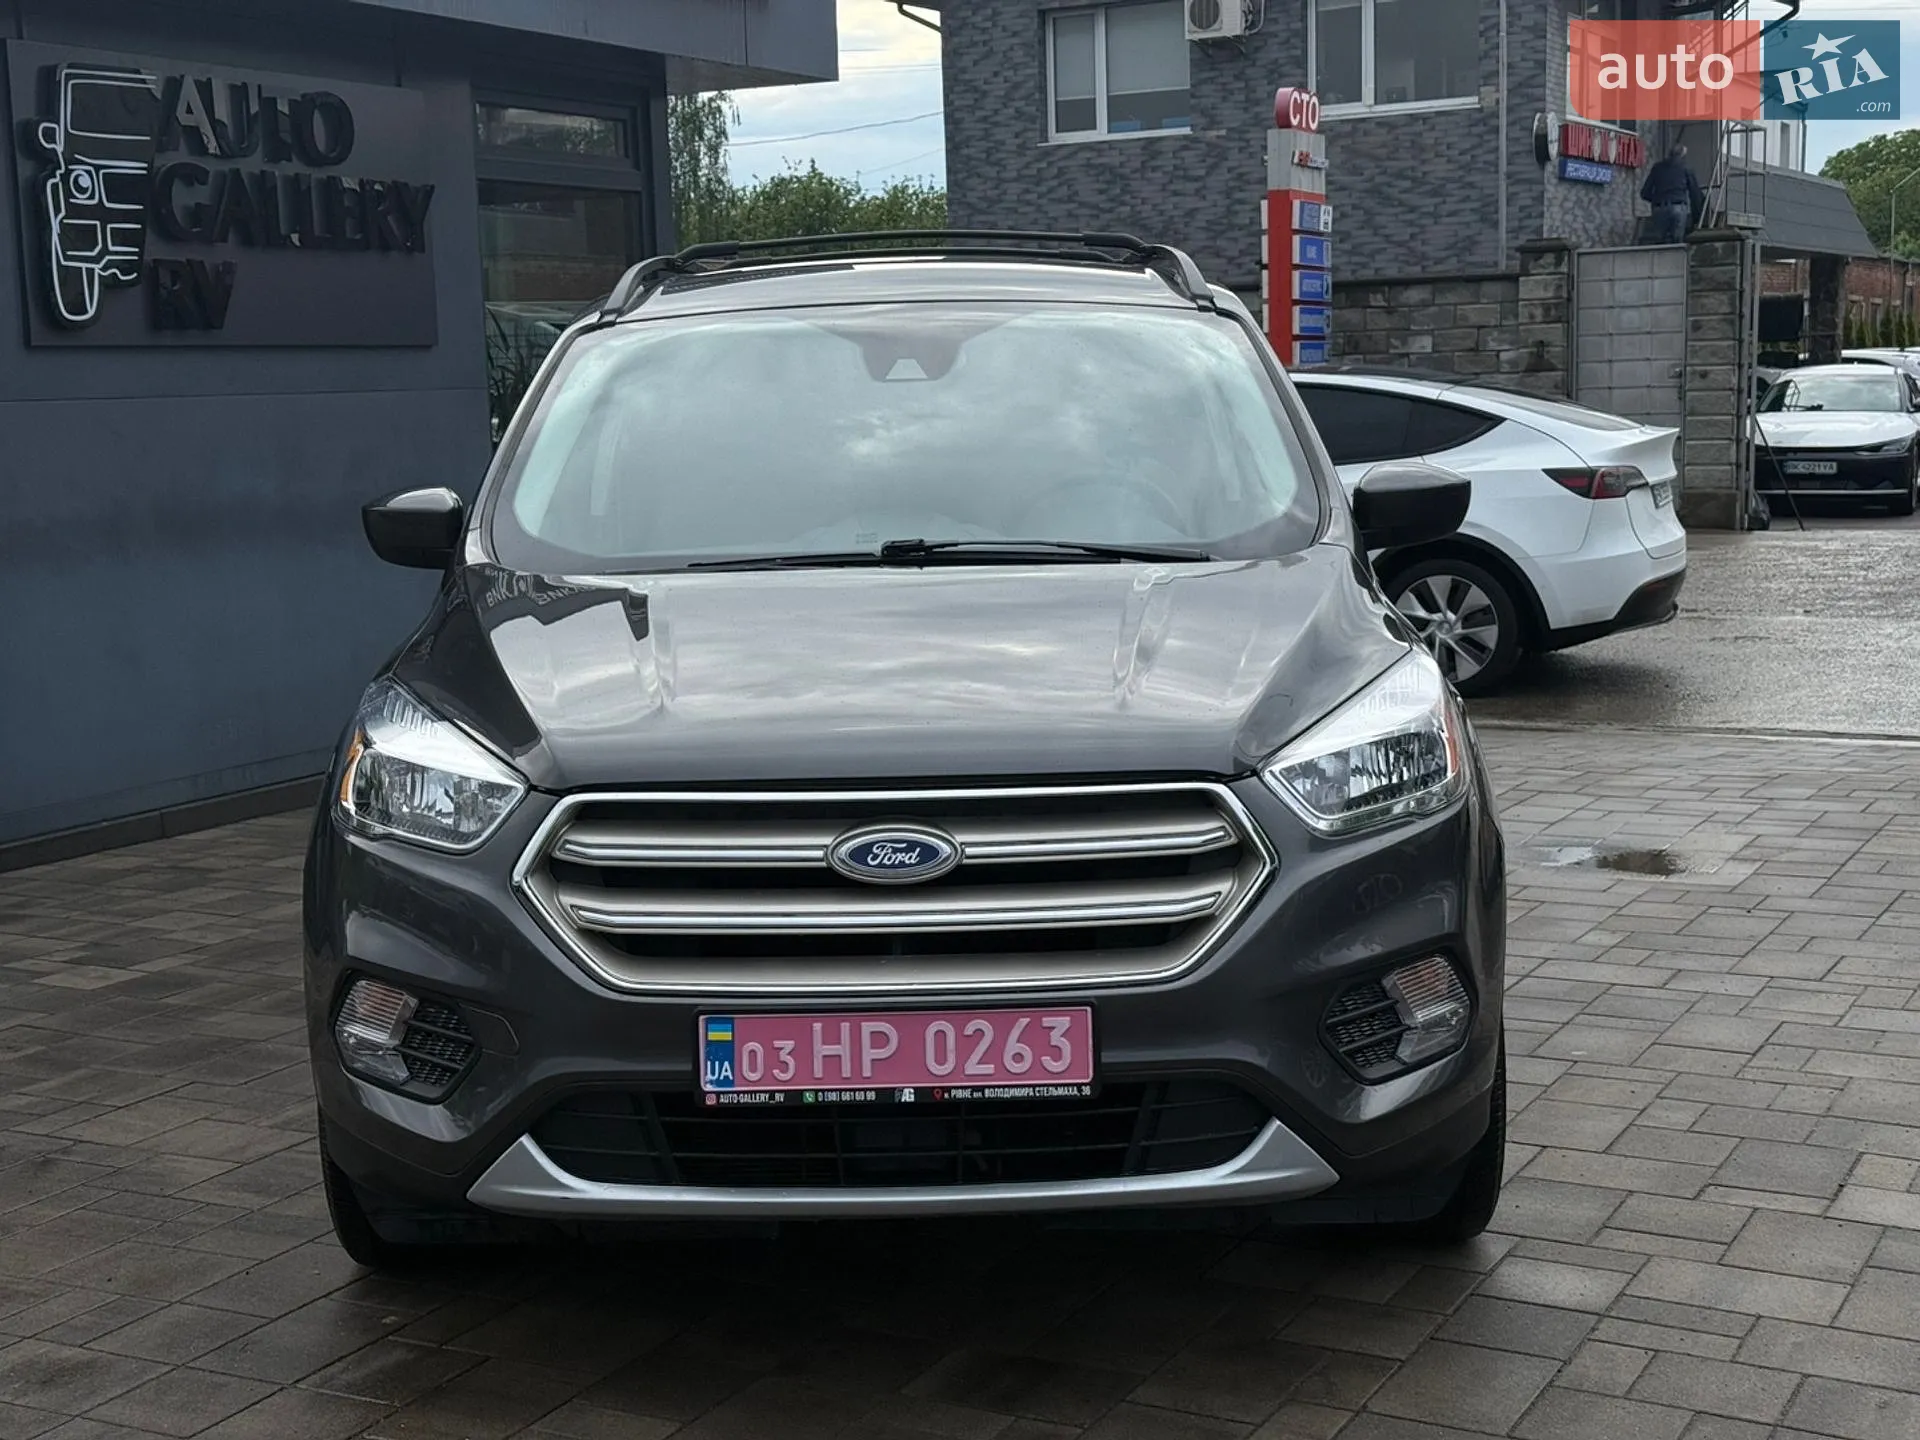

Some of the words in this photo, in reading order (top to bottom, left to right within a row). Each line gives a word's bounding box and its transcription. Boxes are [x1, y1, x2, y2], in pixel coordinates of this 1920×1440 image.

[157, 73, 355, 167] AUTO
[1289, 90, 1320, 131] СТО
[152, 161, 436, 254] GALLERY
[152, 258, 239, 329] RV
[866, 841, 921, 866] Ford
[706, 1060, 734, 1081] UA
[741, 1040, 797, 1082] 03
[812, 1021, 899, 1079] HP
[924, 1016, 1072, 1077] 0263
[951, 1088, 973, 1099] РІВНЕ
